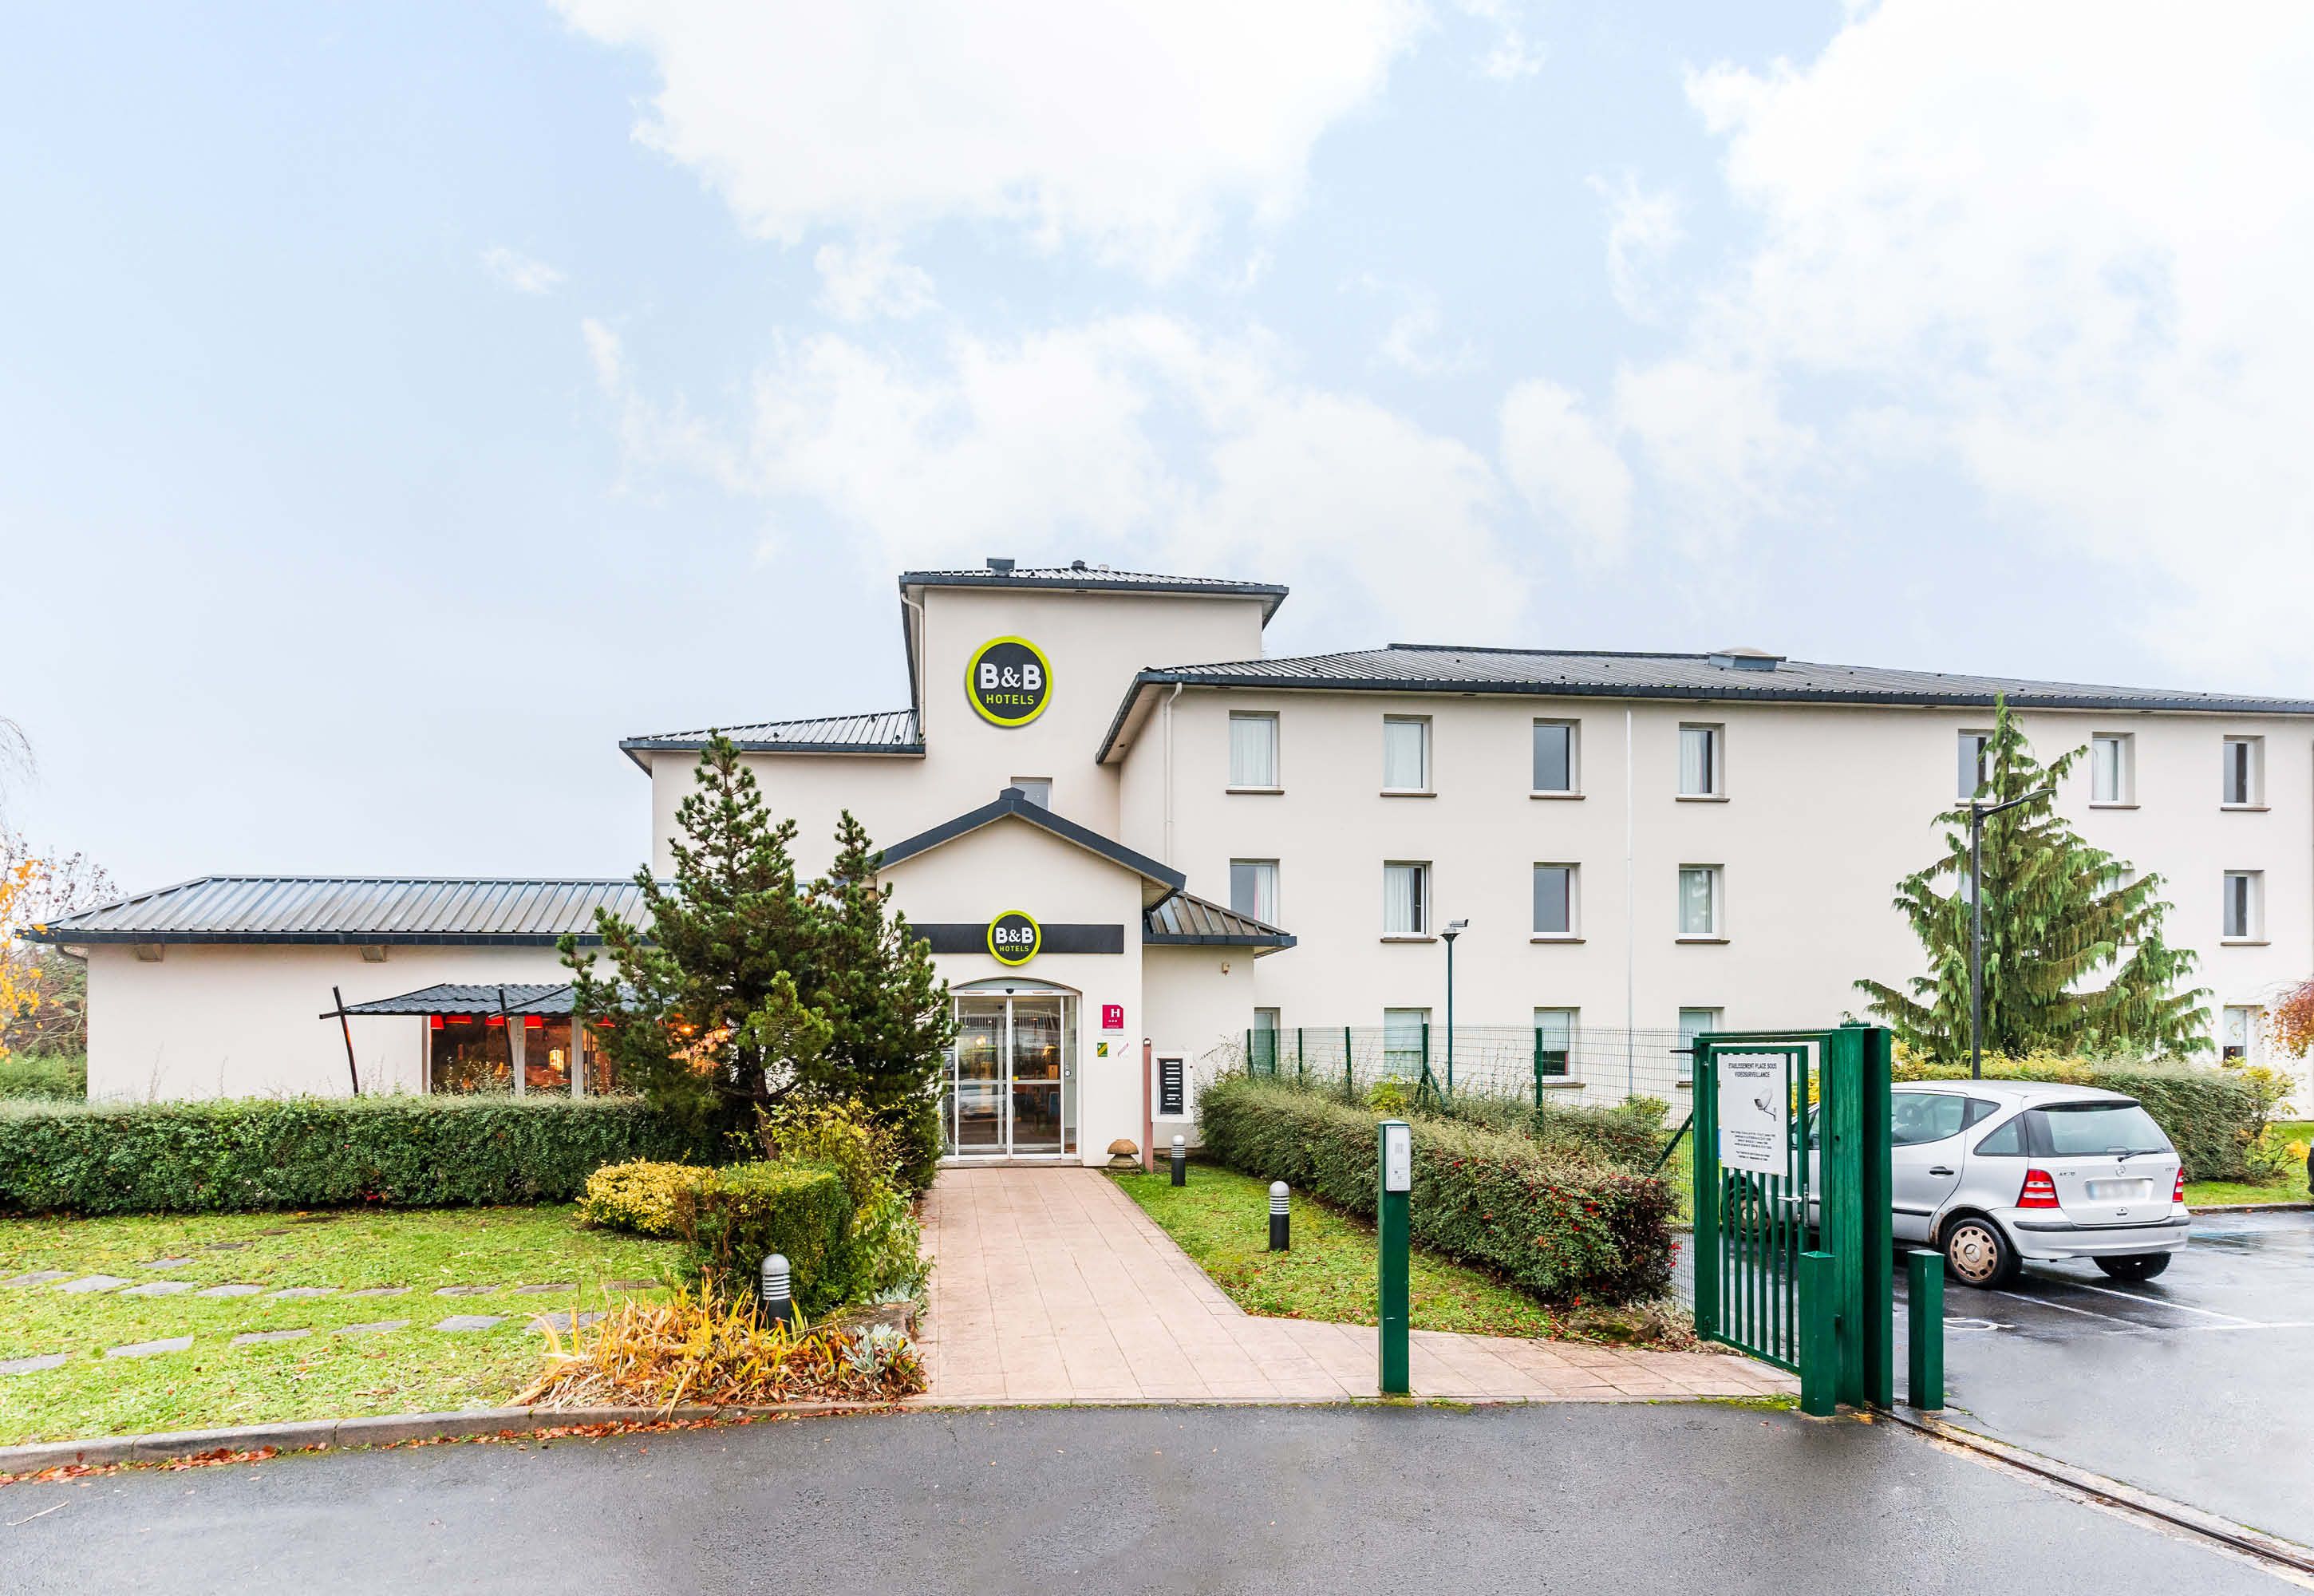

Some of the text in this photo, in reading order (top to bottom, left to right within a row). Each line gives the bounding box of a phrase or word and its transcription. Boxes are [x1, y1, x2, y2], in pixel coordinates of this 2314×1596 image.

[981, 663, 1041, 690] B&B
[985, 694, 1034, 705] HOTELS
[995, 927, 1033, 943] B&B
[1111, 1008, 1120, 1017] H
